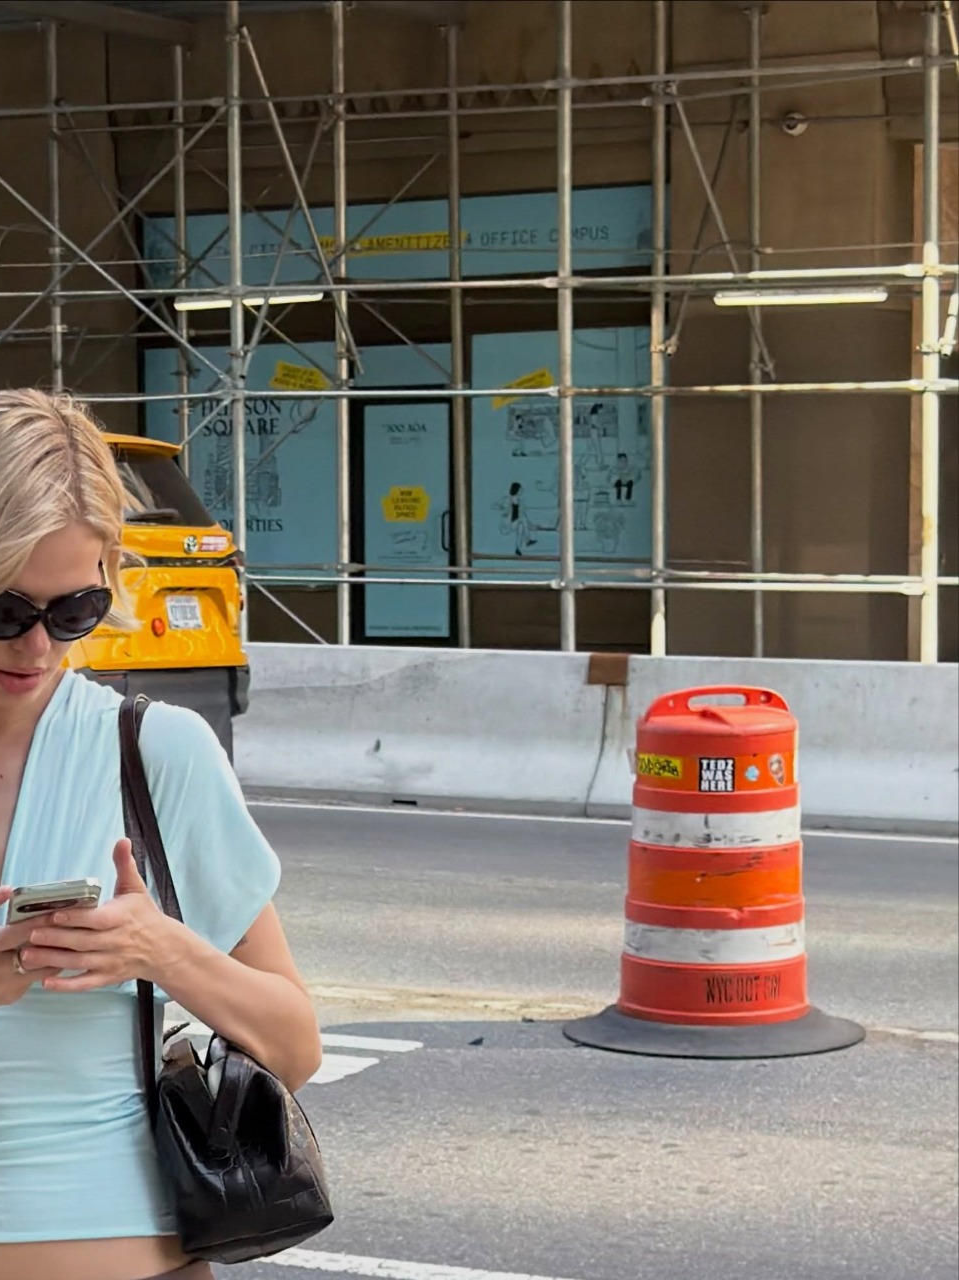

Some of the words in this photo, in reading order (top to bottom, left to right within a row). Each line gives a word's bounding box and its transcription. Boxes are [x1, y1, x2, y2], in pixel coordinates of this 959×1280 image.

[480, 226, 539, 247] OFFICE
[548, 225, 610, 244] CMPUS
[203, 419, 280, 437] SQARE
[700, 758, 734, 771] TEDZ
[701, 770, 733, 781] WAS
[700, 780, 734, 792] HERE
[705, 975, 733, 1004] NYC
